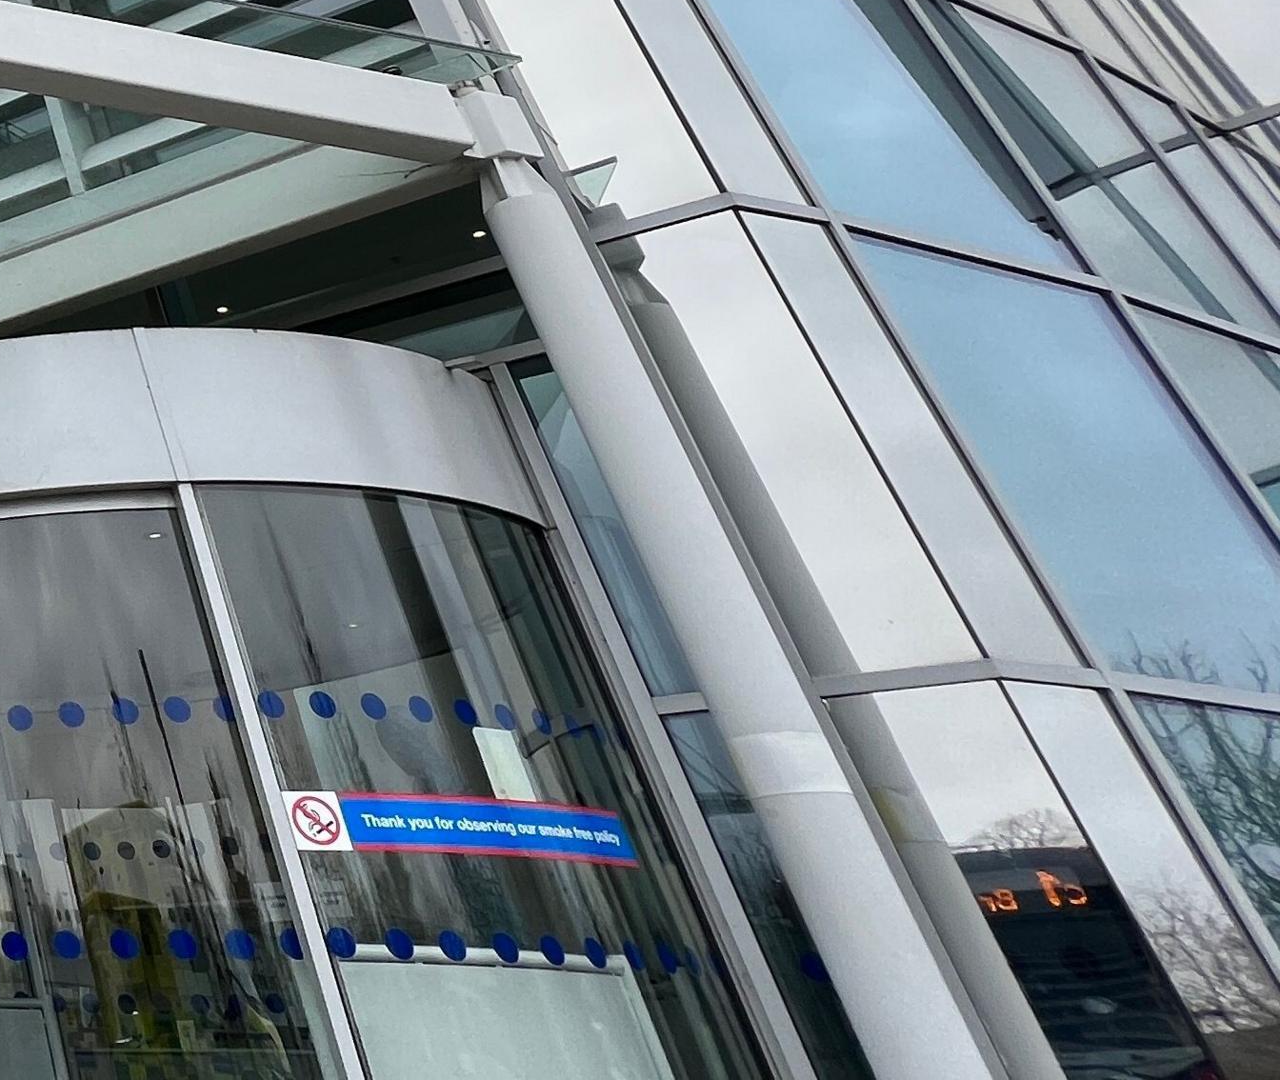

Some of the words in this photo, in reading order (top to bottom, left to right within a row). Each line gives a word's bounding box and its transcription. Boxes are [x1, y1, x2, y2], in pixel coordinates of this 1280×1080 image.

[360, 813, 406, 828] Thank
[408, 818, 434, 831] you
[435, 816, 454, 830] for
[457, 818, 517, 837] observing
[518, 823, 536, 835] our
[538, 824, 574, 839] smoke
[573, 826, 594, 841] free
[594, 830, 621, 847] policy
